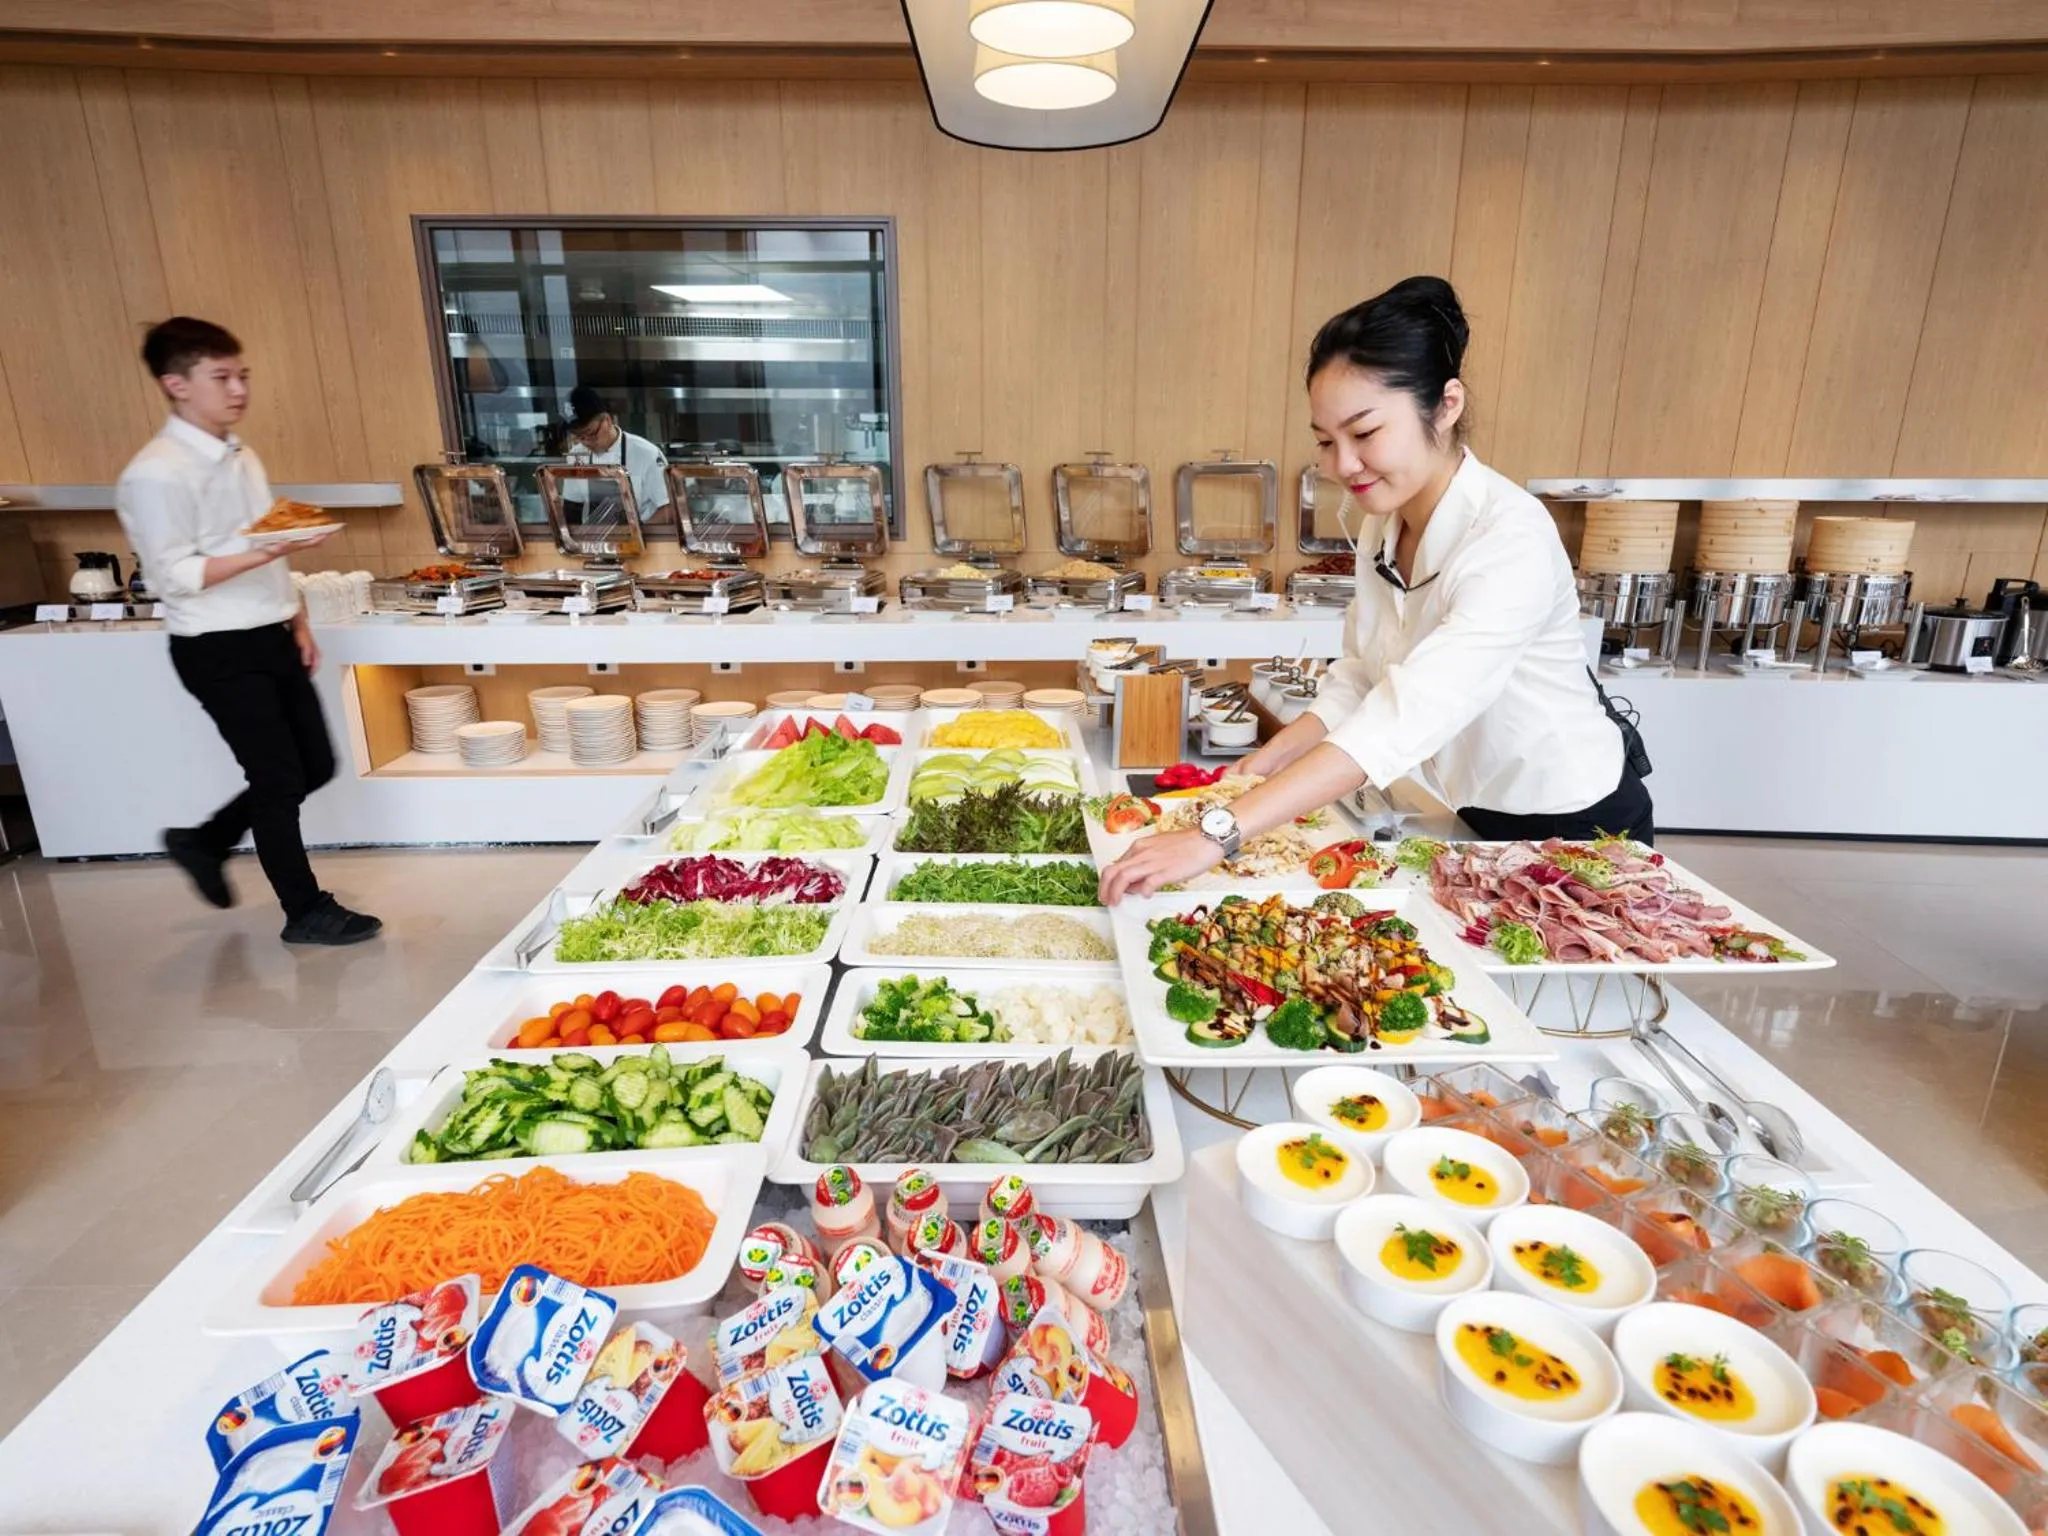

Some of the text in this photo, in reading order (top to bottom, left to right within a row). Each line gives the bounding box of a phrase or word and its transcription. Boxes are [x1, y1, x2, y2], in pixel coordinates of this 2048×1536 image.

[729, 1297, 794, 1346] Zottis
[832, 1269, 892, 1329] Zottis
[953, 1282, 988, 1353] Zottis
[367, 1316, 396, 1374] Zottis
[545, 1307, 598, 1385] Zottis
[577, 1398, 626, 1443] Zottis
[786, 1369, 824, 1429] Zottis
[869, 1393, 950, 1441] Zottis
[1002, 1408, 1074, 1440] Zottis
[1020, 1435, 1048, 1449] fruit
